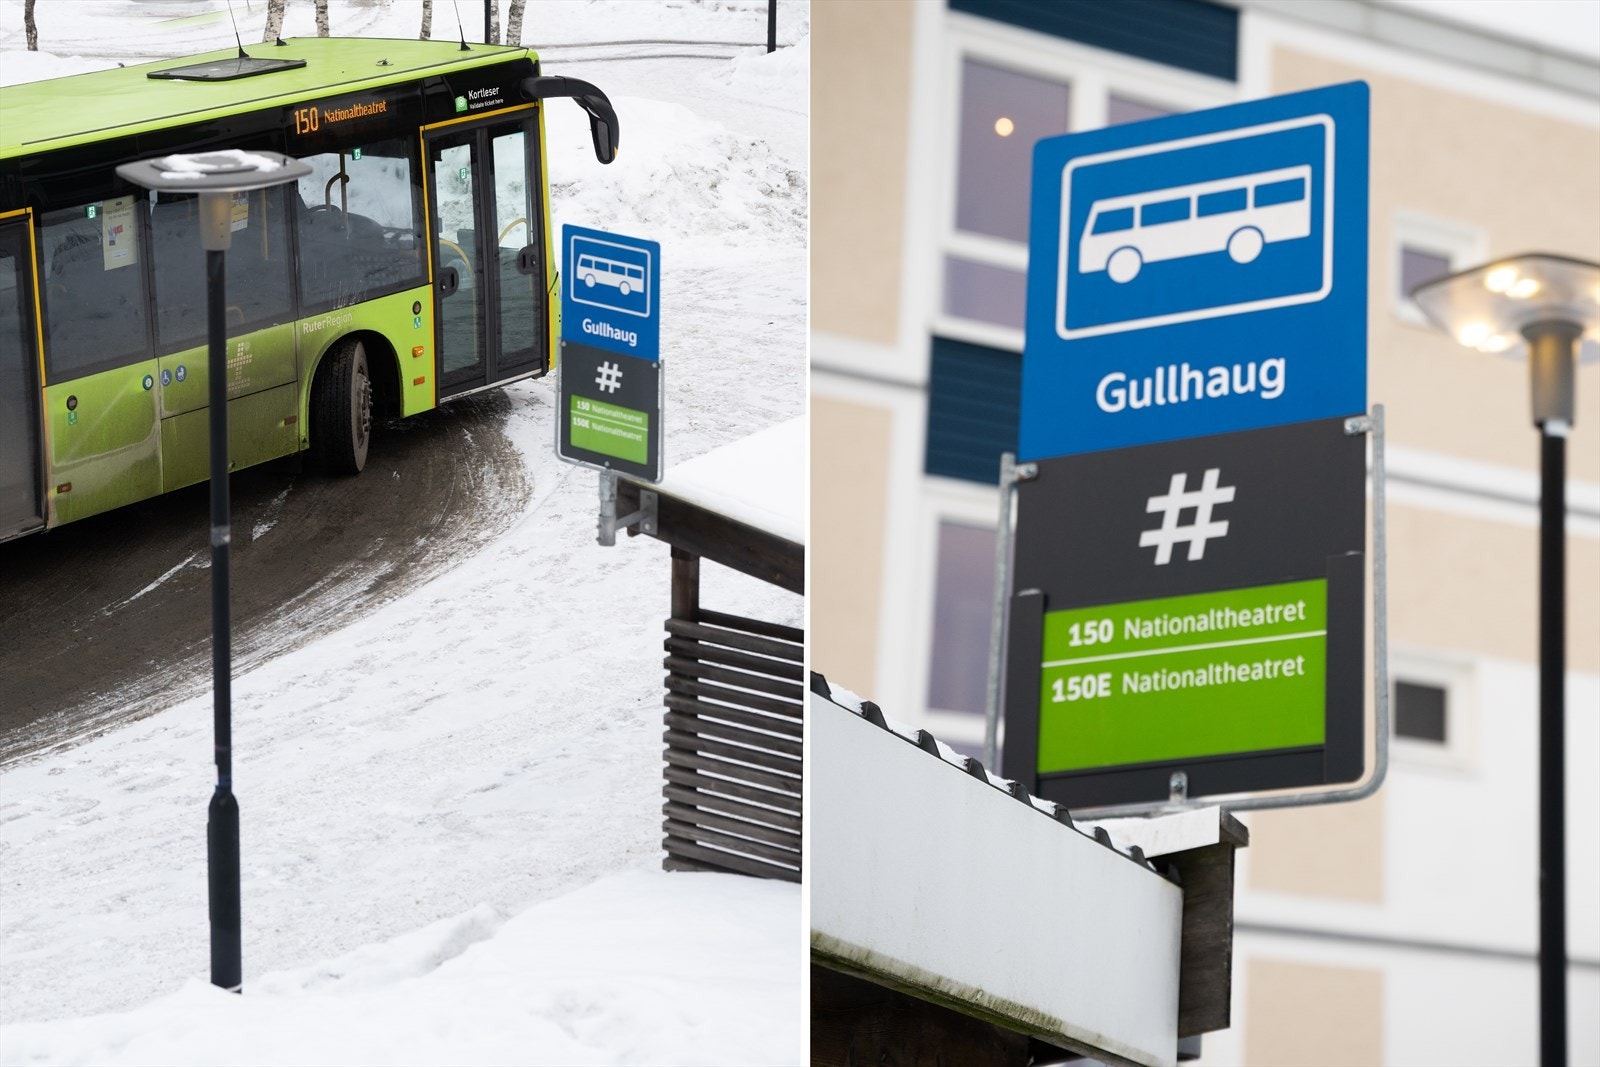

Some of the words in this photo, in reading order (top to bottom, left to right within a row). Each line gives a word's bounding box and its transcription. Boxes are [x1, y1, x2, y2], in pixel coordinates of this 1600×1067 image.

[468, 87, 500, 100] Kortleser
[294, 106, 319, 135] 150
[324, 100, 387, 124] Nationaltheatret
[303, 312, 353, 335] RuterRegion
[582, 317, 638, 347] Gullhaug
[1096, 357, 1286, 413] Gullhaug
[576, 400, 591, 411] 150
[592, 404, 643, 424] Nationaltheatret
[573, 416, 590, 429] 150E
[592, 421, 643, 442] Nationaltheatret
[1068, 618, 1114, 648] 150
[1123, 600, 1306, 641] Nationaltheatret
[1051, 672, 1112, 704] 150E
[1122, 654, 1305, 695] Nationaltheatret
